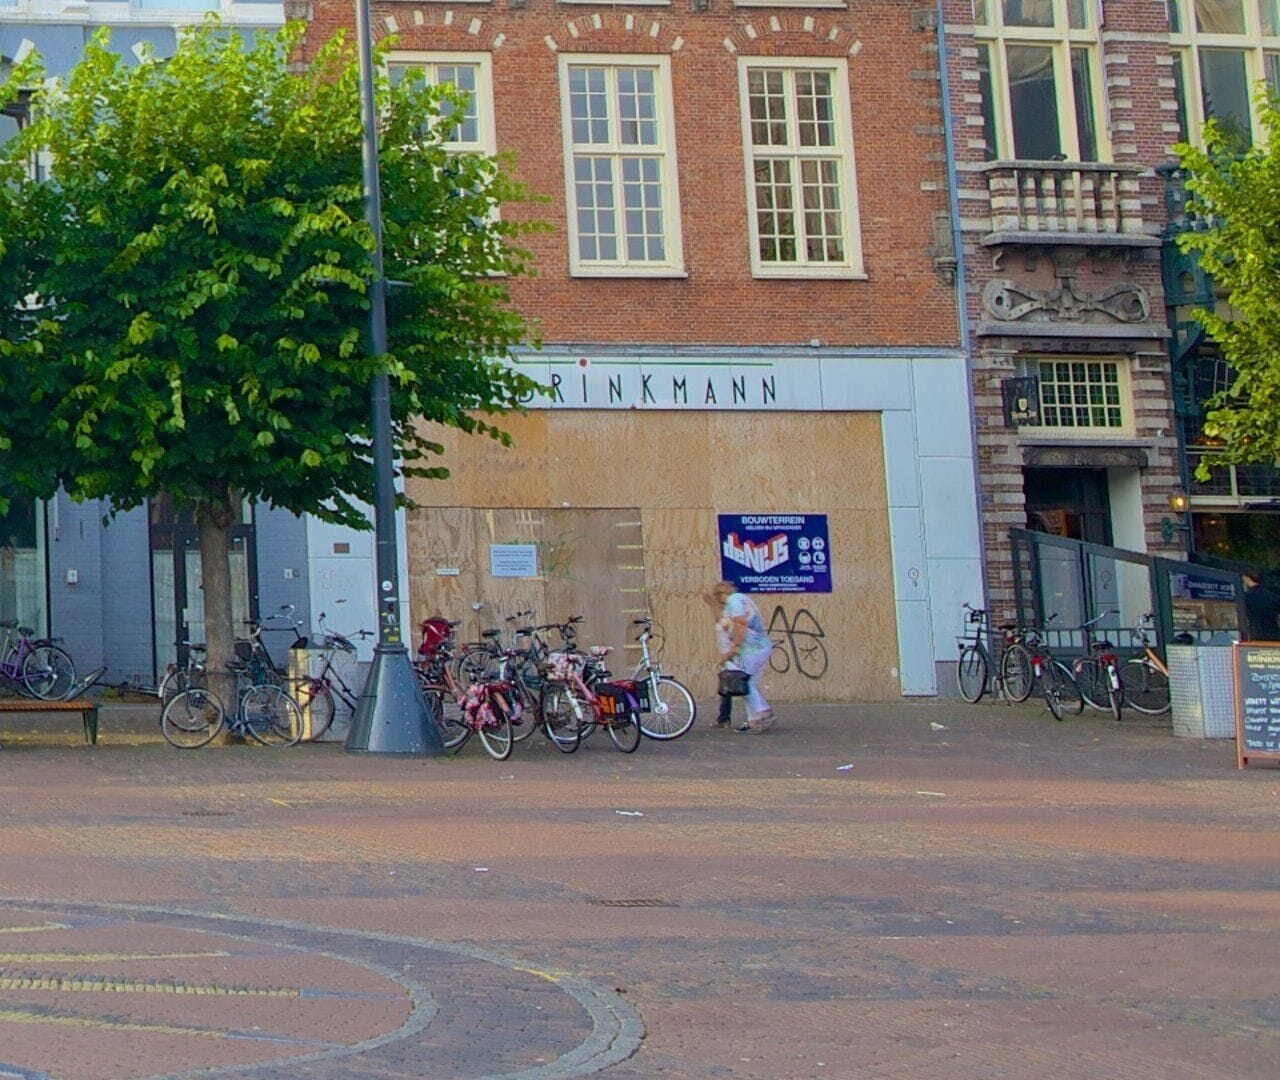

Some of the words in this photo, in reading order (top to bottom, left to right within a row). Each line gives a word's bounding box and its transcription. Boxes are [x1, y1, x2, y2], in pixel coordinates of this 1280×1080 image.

[741, 516, 805, 525] BOUWTERREIN
[741, 576, 780, 584] VERBODEN
[781, 576, 814, 584] TOEGANG
